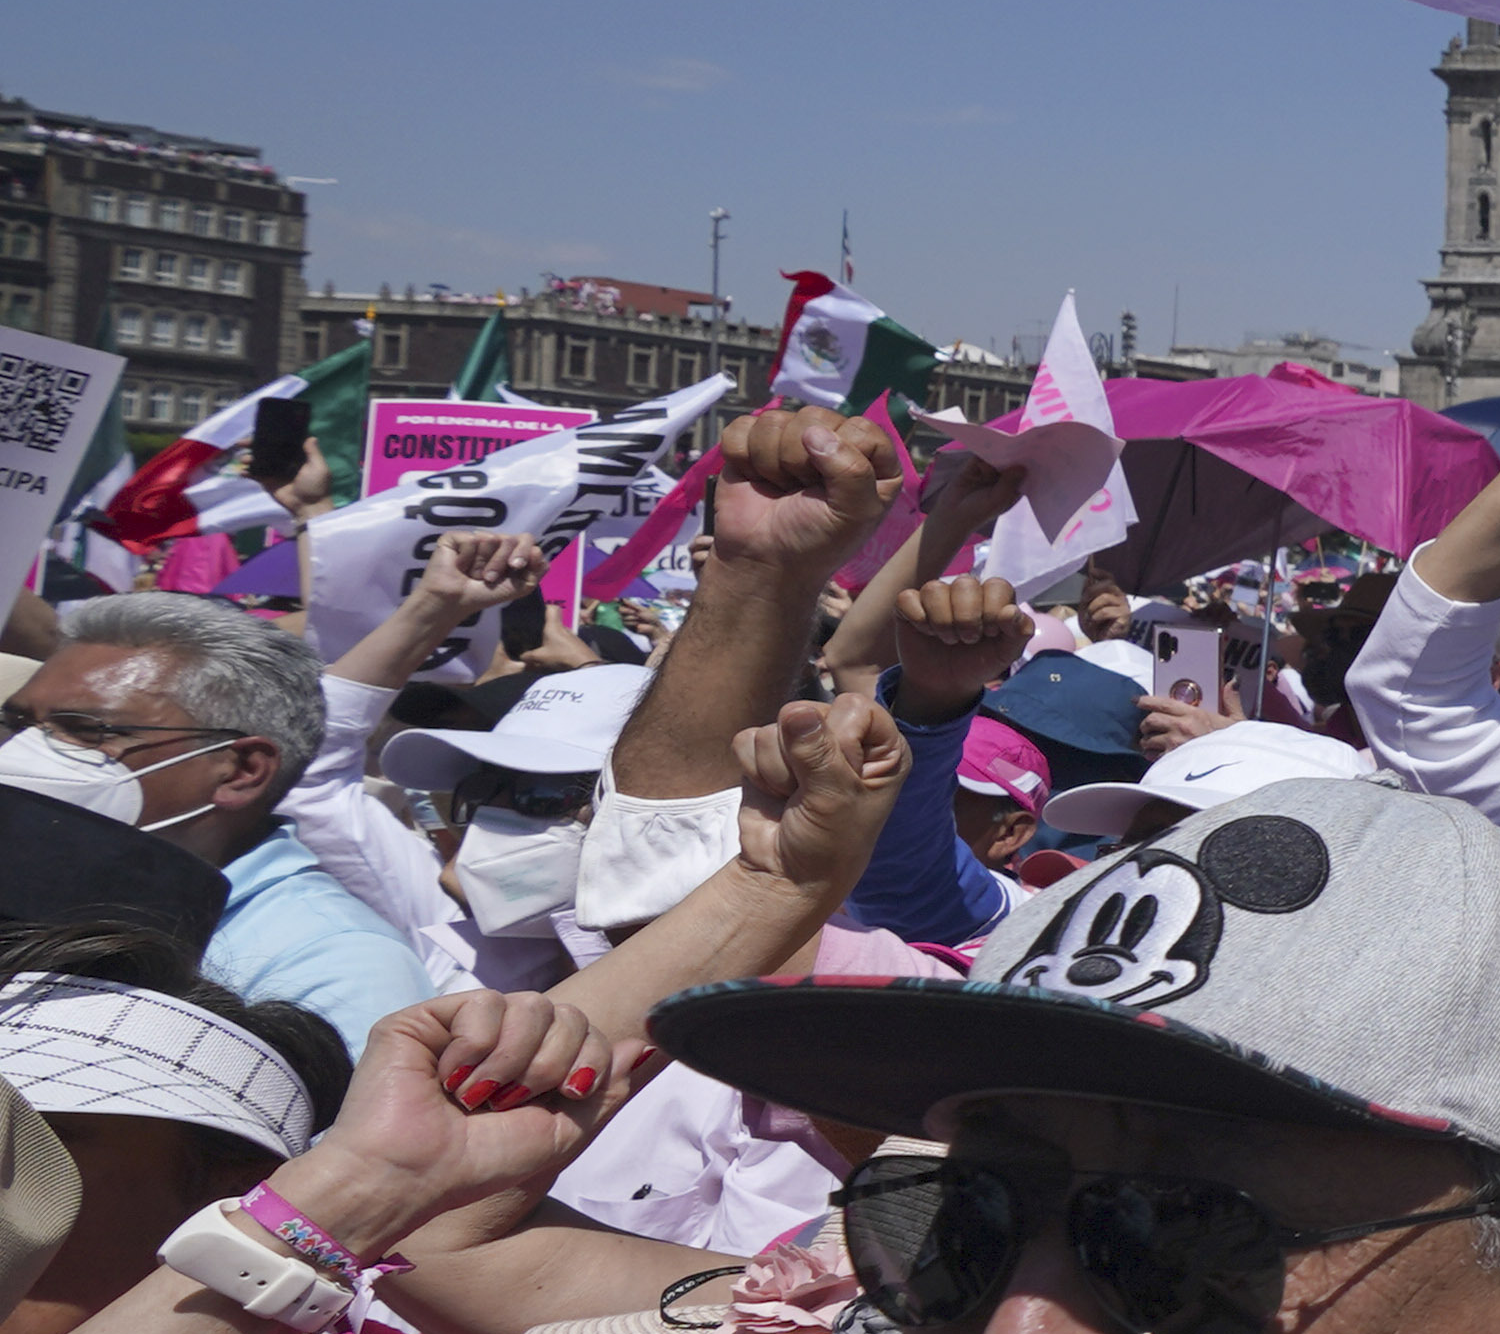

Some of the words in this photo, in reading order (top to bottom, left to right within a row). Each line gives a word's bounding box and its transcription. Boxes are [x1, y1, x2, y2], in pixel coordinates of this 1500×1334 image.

[396, 415, 436, 425] POR
[437, 416, 511, 429] ENCIMA
[513, 421, 541, 430] DE
[383, 434, 527, 462] CONSTITU
